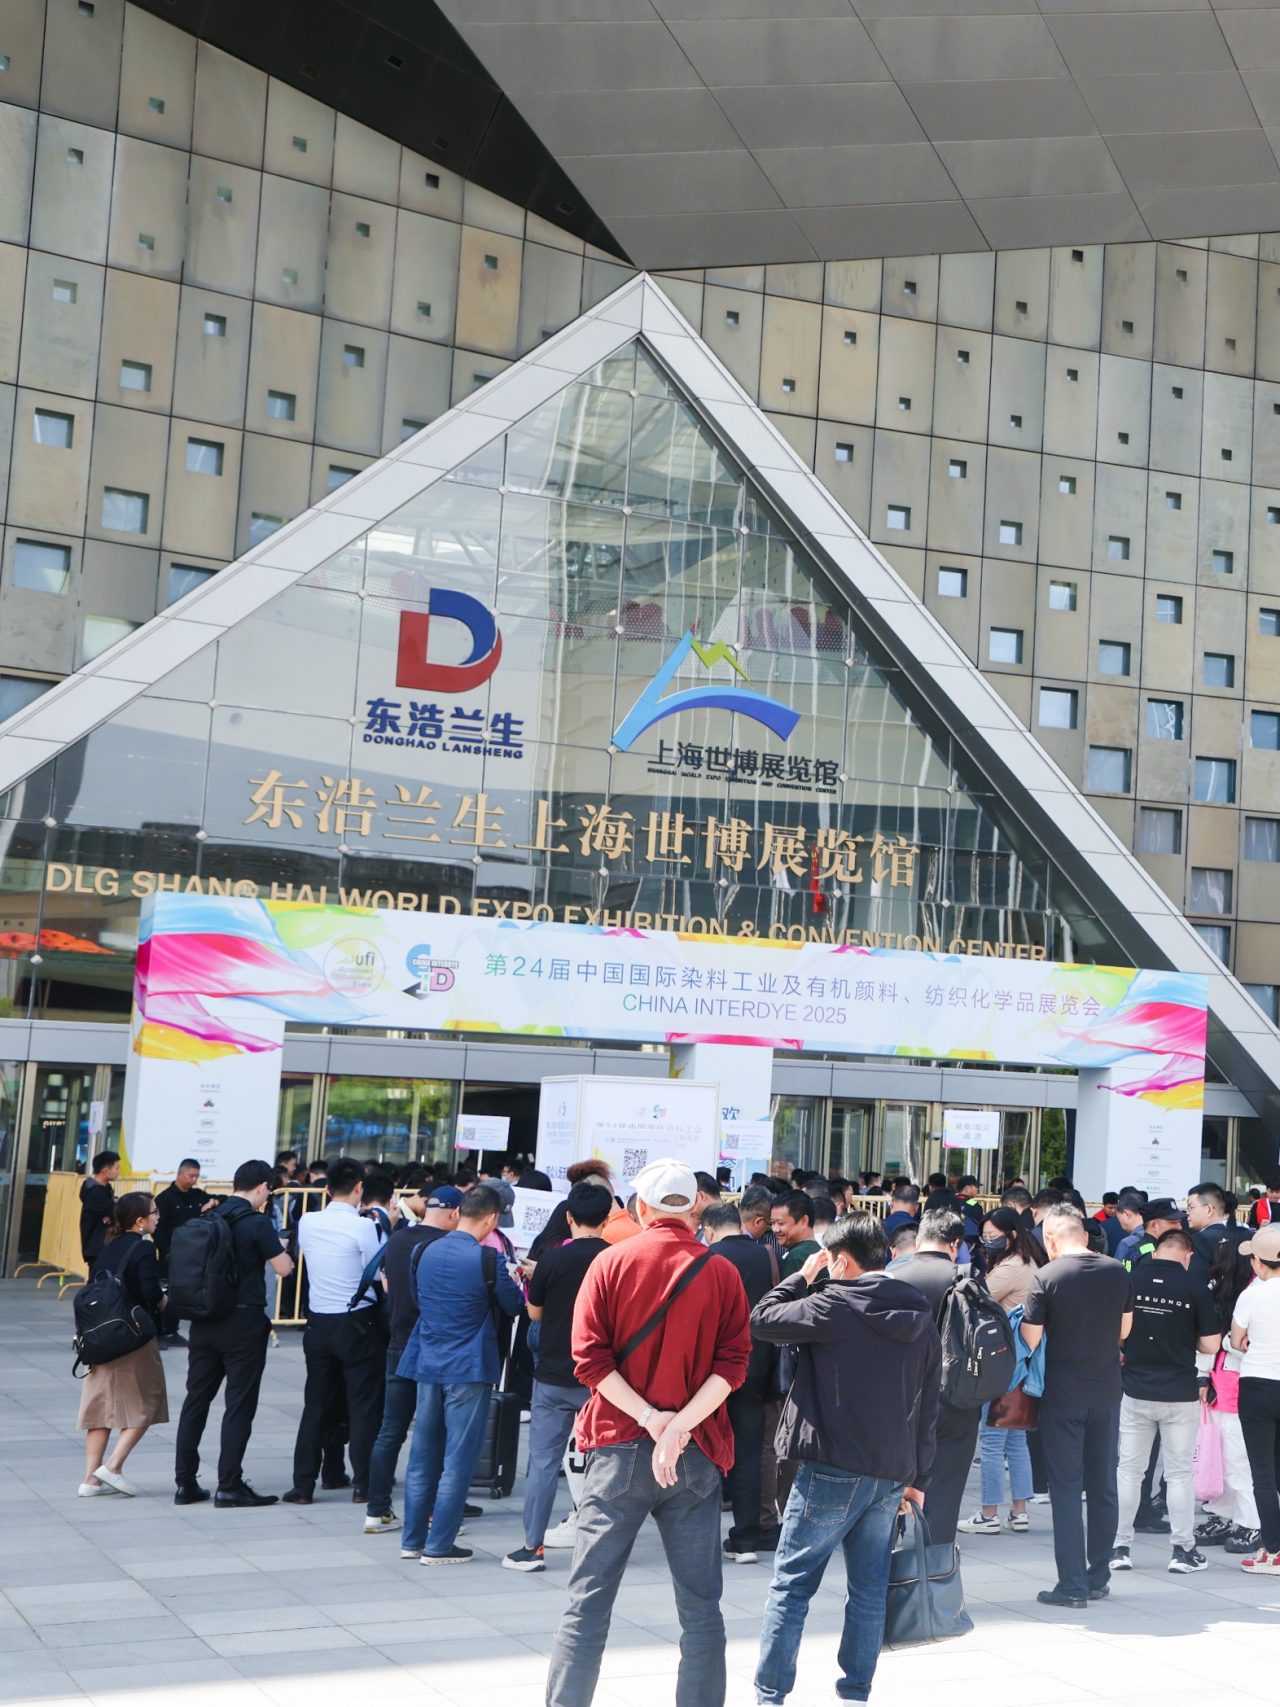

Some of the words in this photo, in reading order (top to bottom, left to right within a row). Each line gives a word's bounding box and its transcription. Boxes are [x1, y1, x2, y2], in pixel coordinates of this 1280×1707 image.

[363, 733, 436, 750] DONGHAO
[442, 742, 523, 760] LANSHENG
[364, 697, 524, 748] 东浩兰生
[647, 739, 840, 787] 上海世博展览馆
[245, 770, 920, 888] 东浩兰生上海世博展览馆
[46, 862, 120, 897] DLG
[131, 870, 257, 899] SHANG
[271, 881, 328, 908] HAI
[472, 897, 555, 923] EXPO
[739, 919, 761, 940] &
[355, 951, 376, 967] ufi
[484, 953, 1101, 1017] 第24届中国国际染料工业及有机颜料、纺织化学品展览会
[622, 993, 688, 1015] CHINA
[694, 998, 798, 1022] INTERDYE
[803, 1004, 847, 1025] 2025
